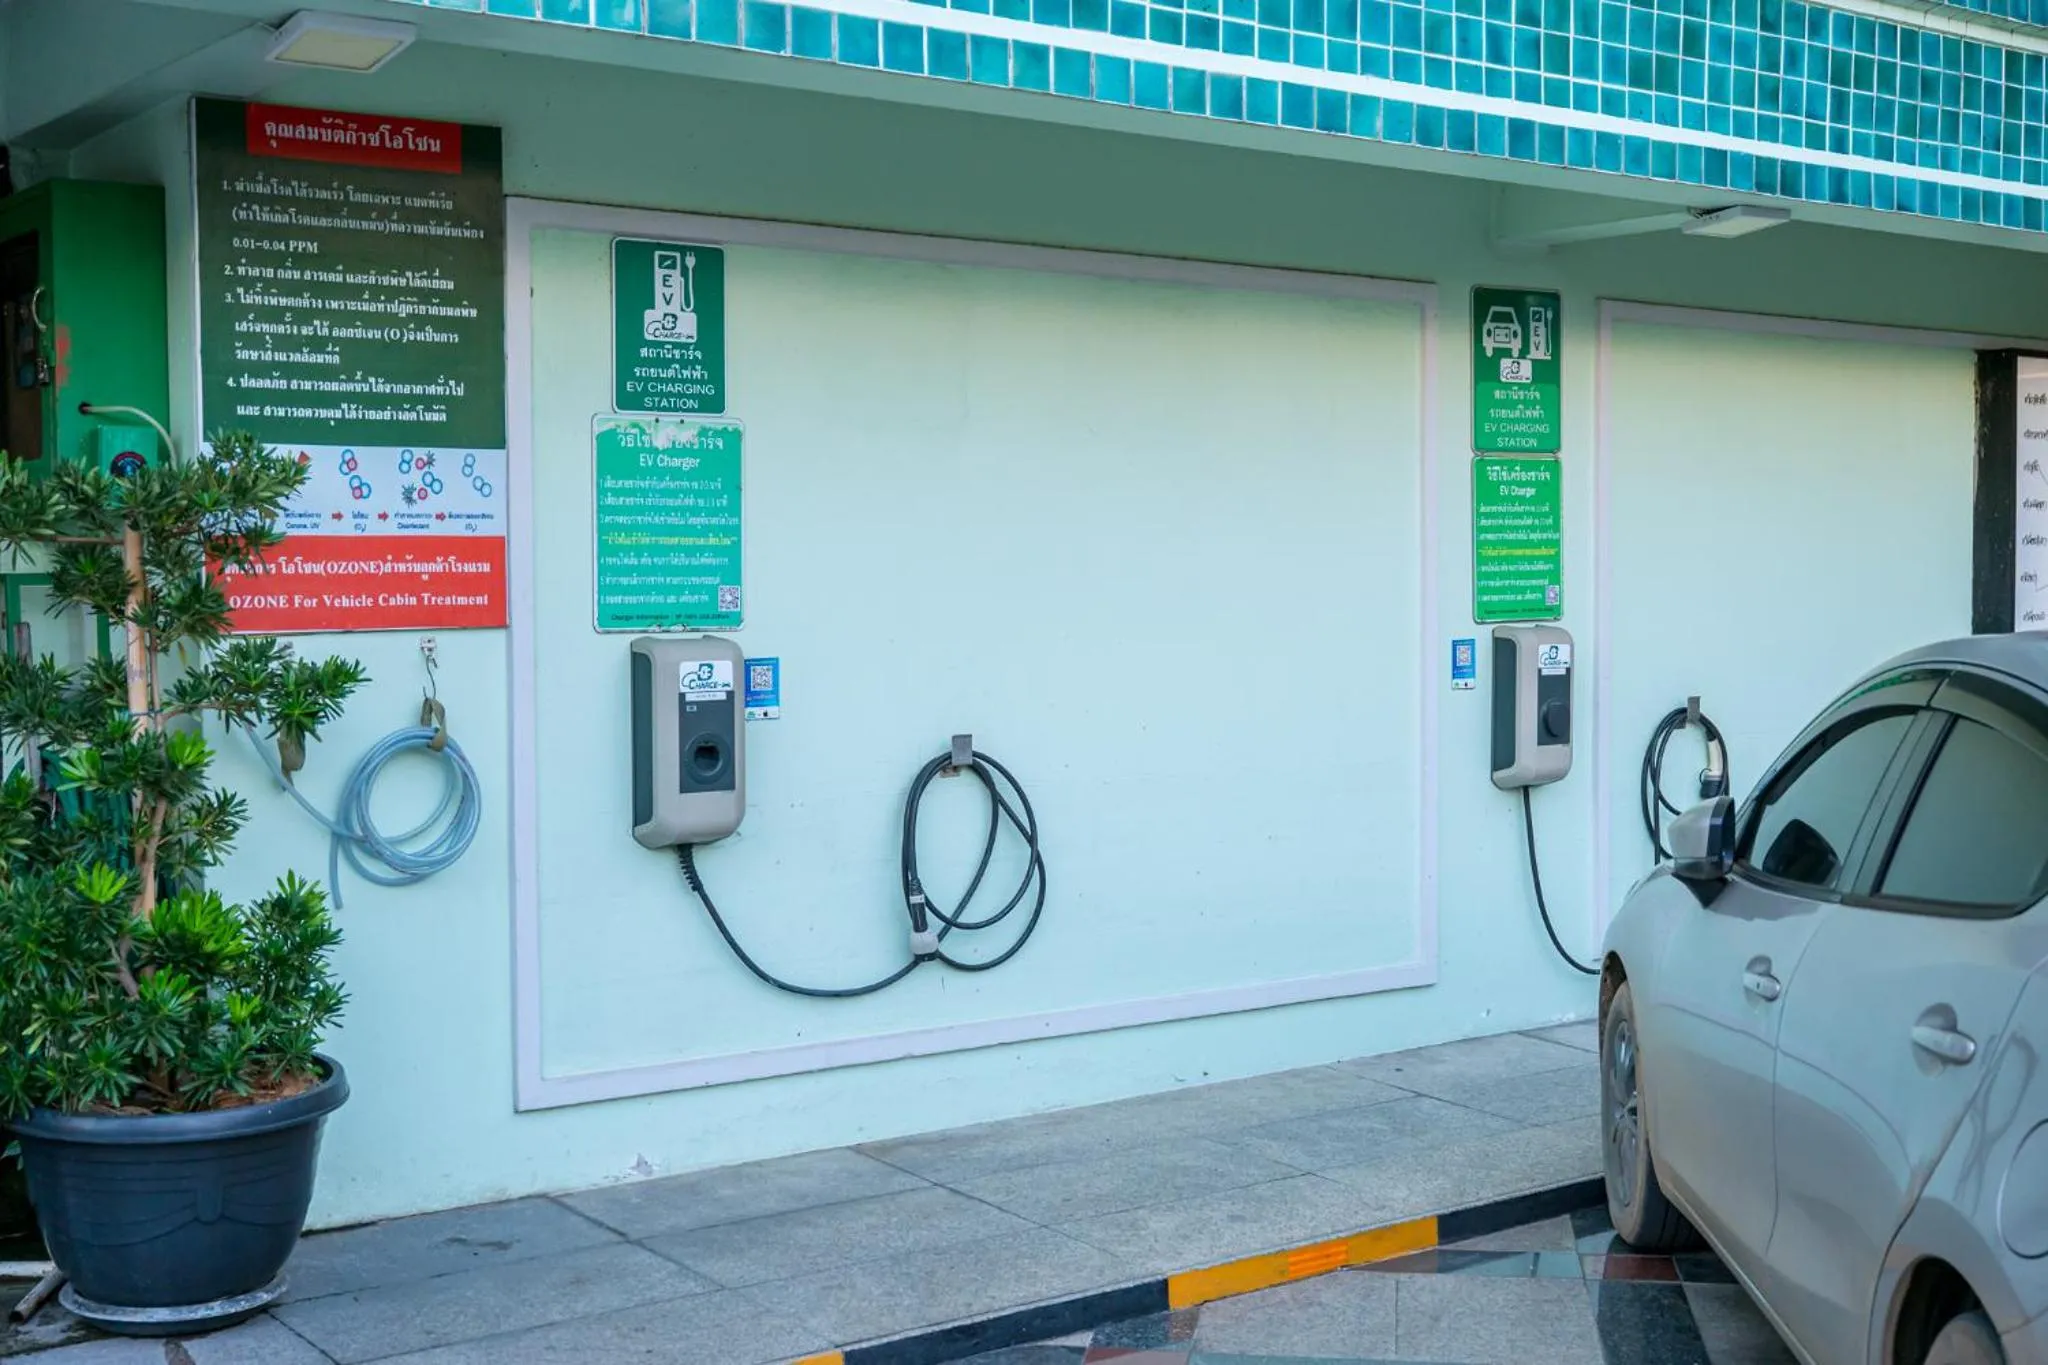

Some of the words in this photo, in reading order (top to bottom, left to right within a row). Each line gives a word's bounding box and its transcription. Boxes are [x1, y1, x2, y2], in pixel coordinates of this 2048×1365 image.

[289, 240, 319, 254] PPM
[224, 264, 234, 275] 2.
[639, 344, 703, 360] สถานีชาร์จ
[633, 364, 708, 381] รถยนต์ไฟฟ้า
[226, 376, 236, 387] 4.
[626, 381, 644, 393] EV
[647, 382, 715, 396] CHARGING
[1493, 385, 1541, 400] สถานีชาร์จ
[644, 396, 699, 410] STATION
[1488, 404, 1545, 419] รถยนต์ไฟฟ้า
[1484, 422, 1498, 433] EV
[1500, 422, 1550, 434] CHARGING
[1497, 437, 1538, 448] STATION
[639, 453, 655, 466] EV
[657, 454, 700, 470] Charger
[1500, 485, 1511, 496] EV
[229, 595, 290, 609] OZONE
[293, 595, 319, 609] For
[323, 593, 375, 608] Vehicle
[378, 592, 418, 606] Cabin
[421, 592, 489, 606] Treatment
